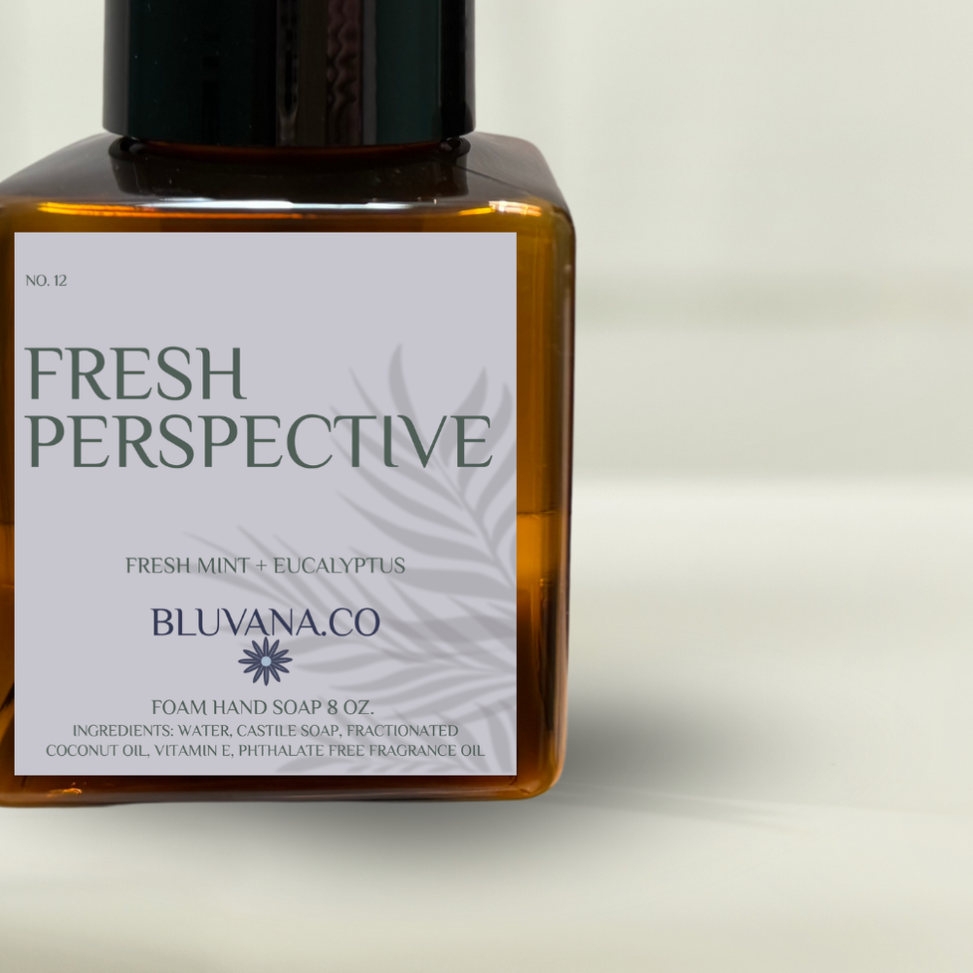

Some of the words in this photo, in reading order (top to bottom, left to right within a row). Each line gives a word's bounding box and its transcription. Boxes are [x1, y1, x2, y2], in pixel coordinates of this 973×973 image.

[26, 275, 49, 286] NO.
[55, 275, 67, 286] 12
[24, 346, 247, 401] FRESH
[24, 414, 492, 469] PERSPECTIVE
[126, 557, 190, 573] FRESH
[198, 558, 250, 574] MINT
[256, 560, 266, 571] +
[273, 557, 405, 573] EUCALYPTUS
[151, 608, 380, 638] BLUVANA.CO
[152, 700, 207, 715] FOAM
[213, 700, 267, 714] HAND
[273, 700, 321, 714] SOAP
[328, 700, 338, 715] 8
[344, 700, 373, 714] OZ.
[74, 725, 173, 736] INGREDIENTS:
[178, 725, 232, 737] WATER,
[237, 725, 296, 736] CASTILE
[301, 725, 342, 737] SOAP,
[347, 725, 458, 736] FRACTIONATED
[46, 745, 116, 756] COCONUT
[123, 745, 149, 756] OIL,
[155, 745, 216, 756] VITAMIN
[223, 745, 233, 756] E,
[239, 745, 323, 756] PHTHALATE
[329, 745, 364, 756] FREE
[370, 744, 456, 756] FRAGRANCE
[461, 744, 485, 756] OIL
